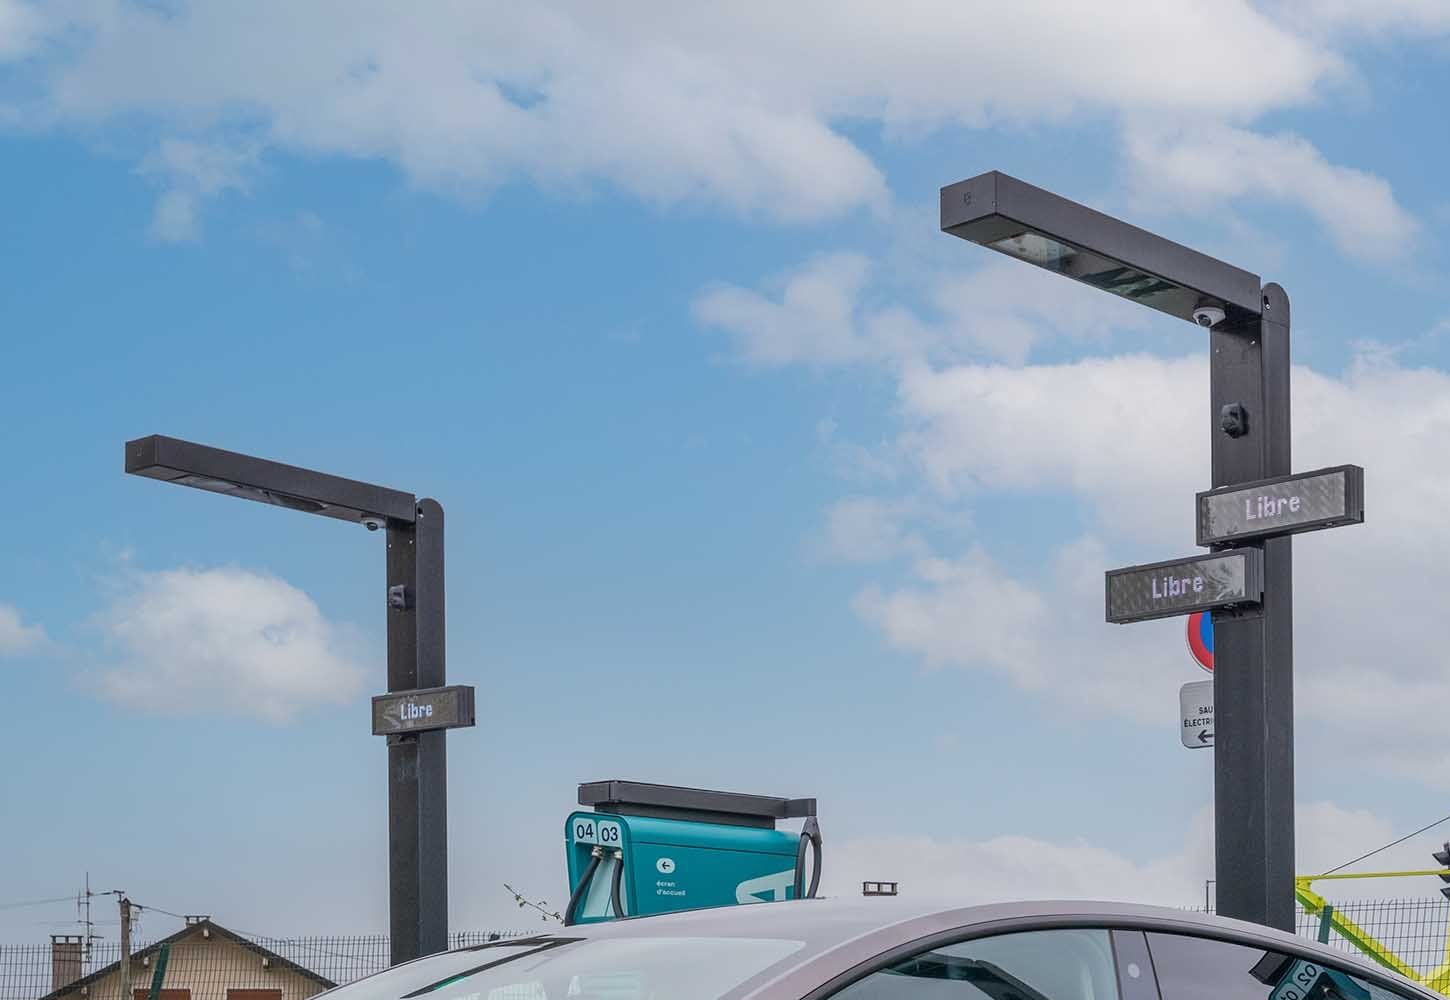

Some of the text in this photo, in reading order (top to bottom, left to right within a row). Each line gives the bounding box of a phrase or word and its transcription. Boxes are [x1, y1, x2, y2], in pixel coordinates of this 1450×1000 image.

[1244, 494, 1301, 521] Libre
[1151, 575, 1204, 599] Libre
[400, 703, 433, 720] Libre
[1199, 705, 1213, 714] SAU
[577, 824, 593, 839] 04
[601, 827, 618, 842] 03
[656, 889, 687, 897] d'accueil
